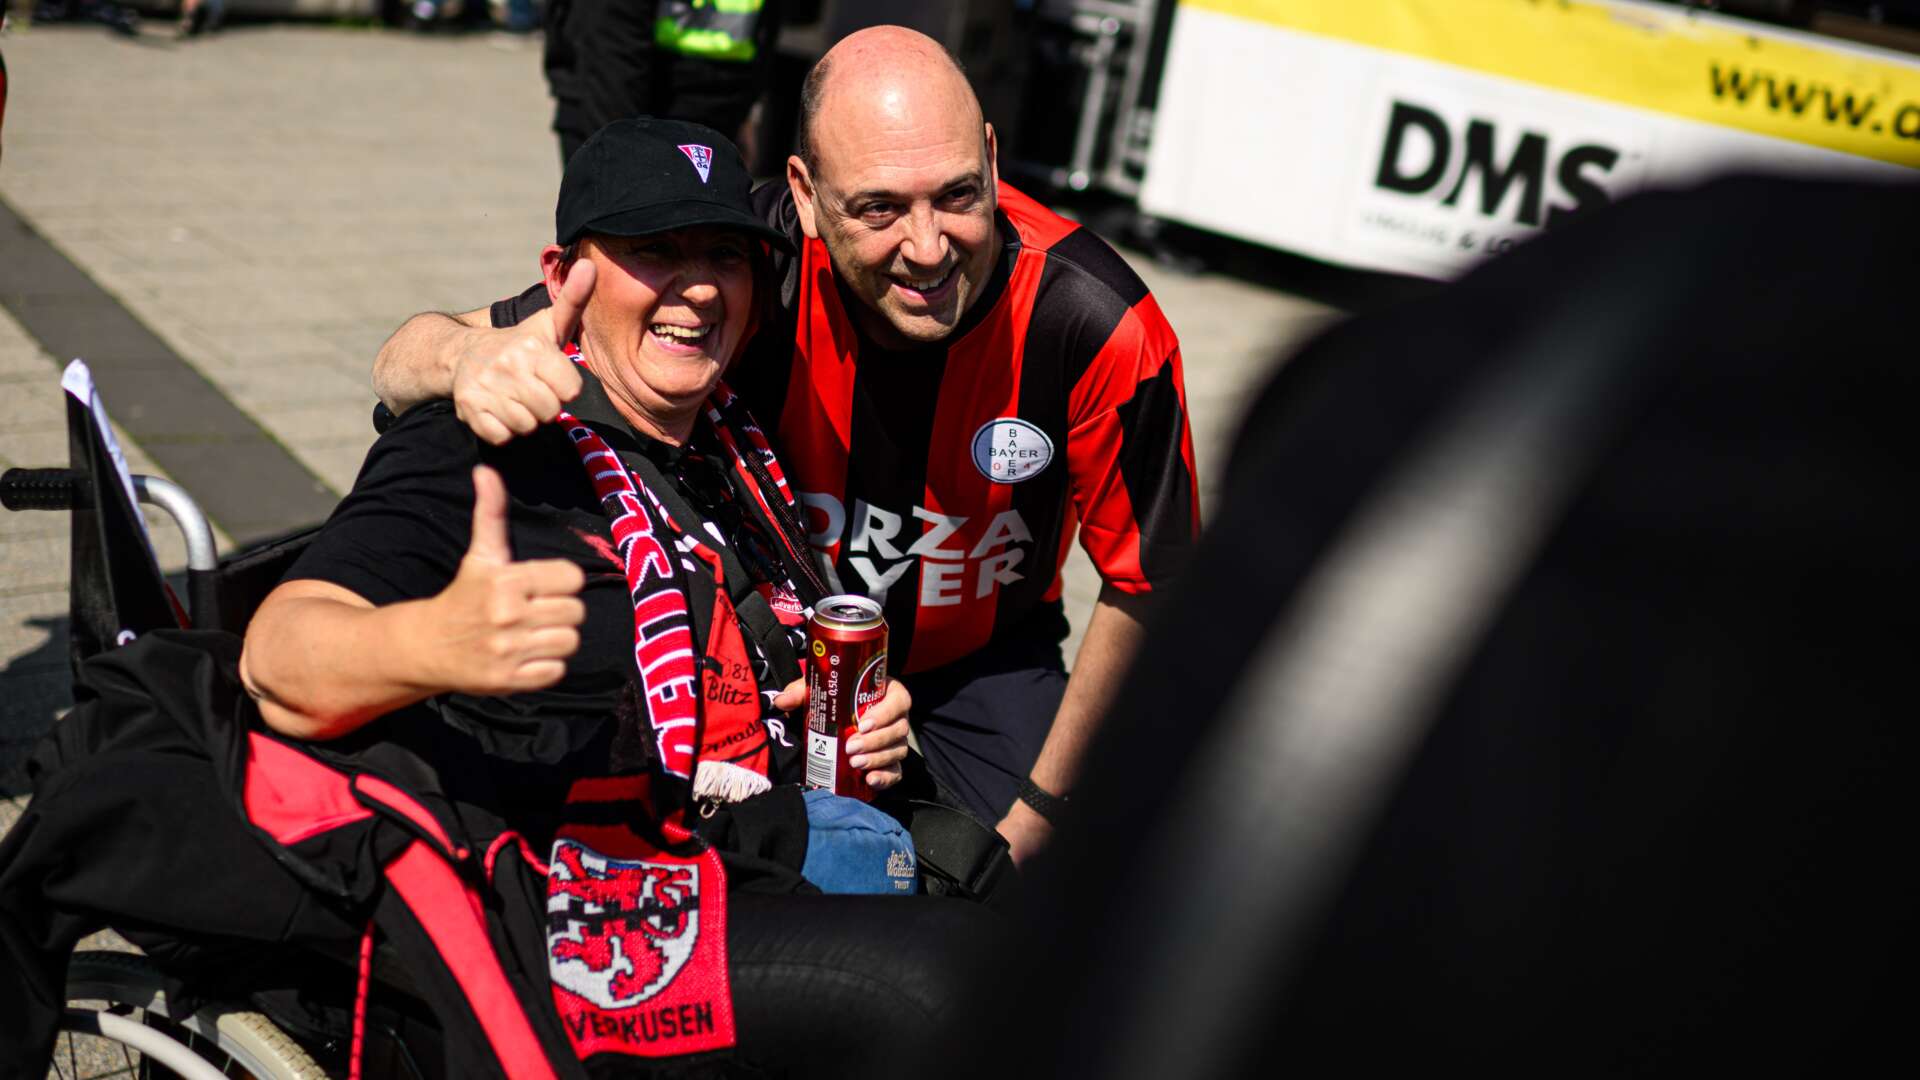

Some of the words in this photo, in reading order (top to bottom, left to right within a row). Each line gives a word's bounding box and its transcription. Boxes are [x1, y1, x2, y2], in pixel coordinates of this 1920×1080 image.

[1375, 99, 1621, 228] DMS
[988, 447, 1039, 459] BAYER
[1008, 428, 1017, 476] BAYER
[707, 676, 753, 706] Blitz
